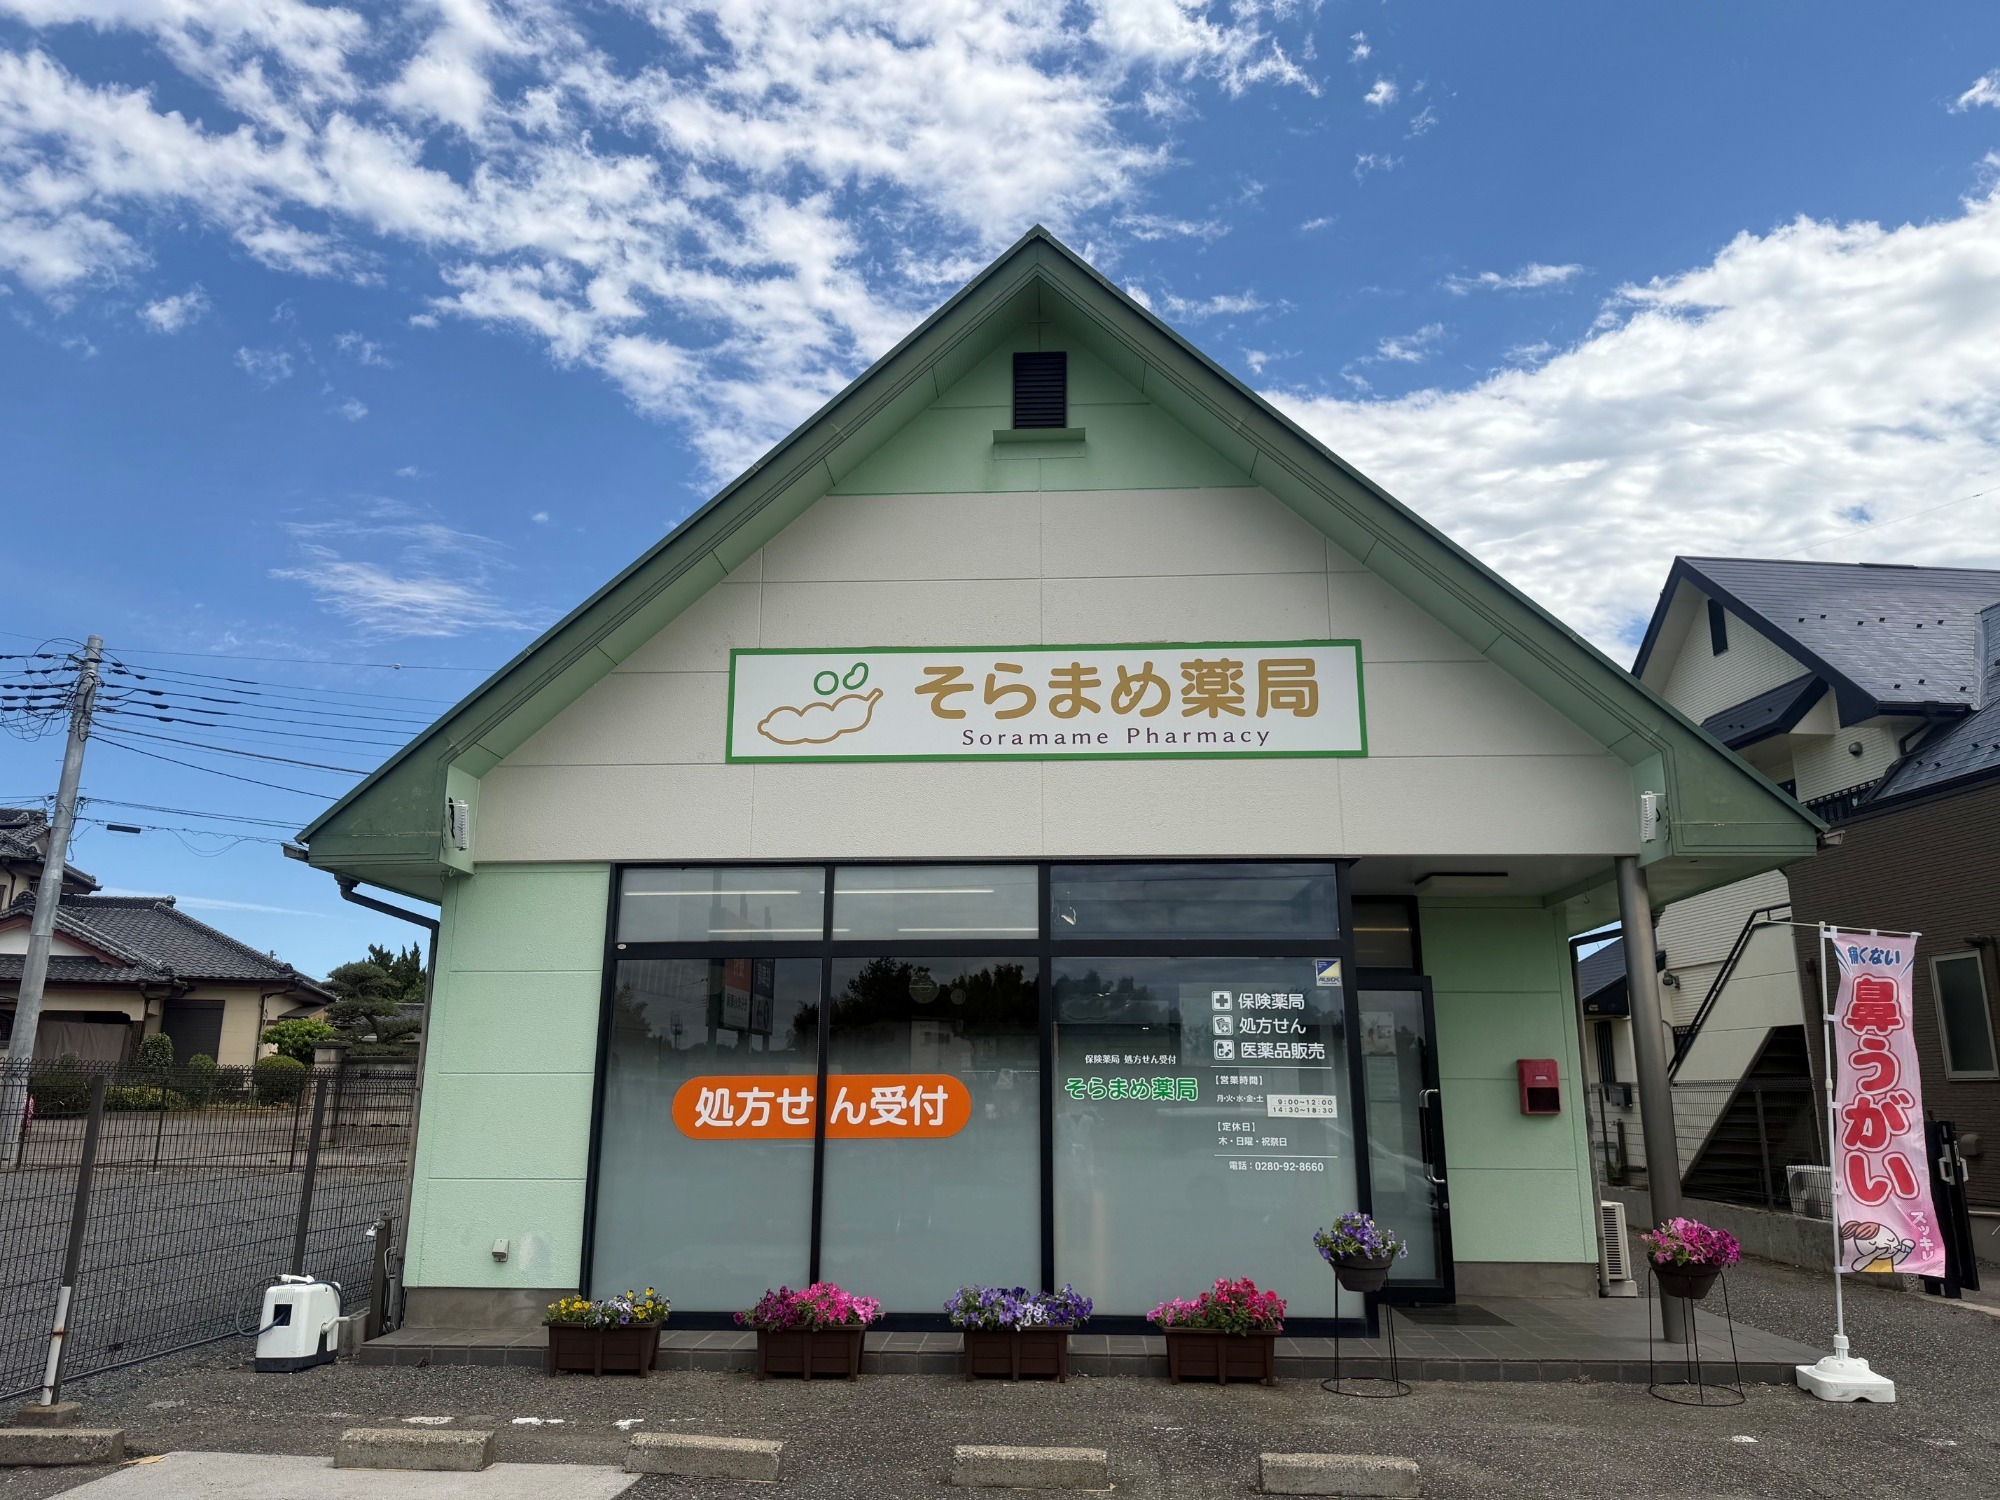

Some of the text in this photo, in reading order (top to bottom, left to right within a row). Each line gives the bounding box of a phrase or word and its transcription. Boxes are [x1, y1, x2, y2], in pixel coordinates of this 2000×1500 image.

[914, 657, 1319, 720] そらまめ薬局
[962, 727, 1271, 747] Soramame Pharmacy
[1847, 945, 1901, 966] 痛くない
[1238, 993, 1305, 1010] 保険薬局
[1239, 1017, 1307, 1034] 処方せん
[1085, 1054, 1176, 1065] 保険薬局 処方せん受付
[1241, 1042, 1325, 1060] 医薬品販売
[1064, 1077, 1198, 1101] そらまめ薬局
[1842, 973, 1920, 1206] 鼻うがい
[695, 1085, 949, 1128] 処方せん受付
